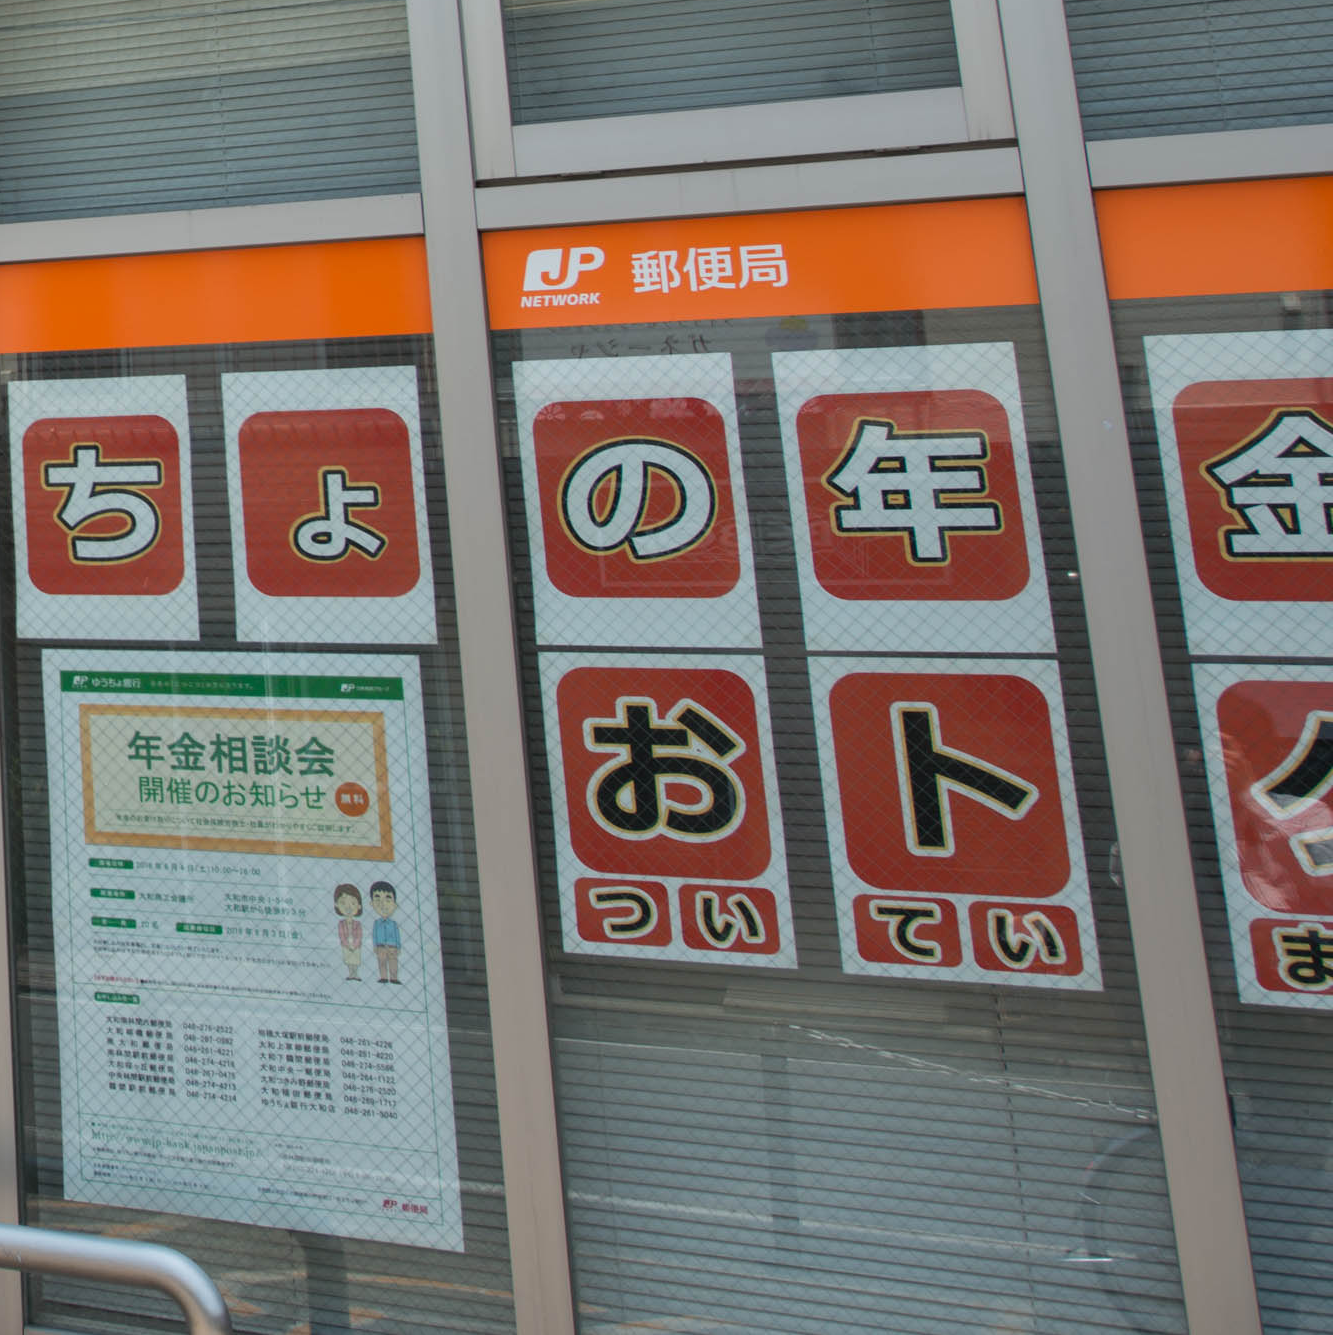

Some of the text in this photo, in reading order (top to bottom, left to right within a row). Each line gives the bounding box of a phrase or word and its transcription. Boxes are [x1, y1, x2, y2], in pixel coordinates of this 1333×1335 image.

[523, 244, 788, 293] JP 郵便局
[520, 293, 600, 308] NETWORK
[43, 443, 164, 563] ち
[558, 436, 718, 564] の
[824, 417, 1003, 566] 年
[91, 678, 141, 689] ゆうちょ銀行
[128, 731, 336, 777] 年金相談会
[139, 777, 326, 810] 開催のお知らせ
[583, 696, 1038, 856] お ト
[341, 793, 365, 805] 無料
